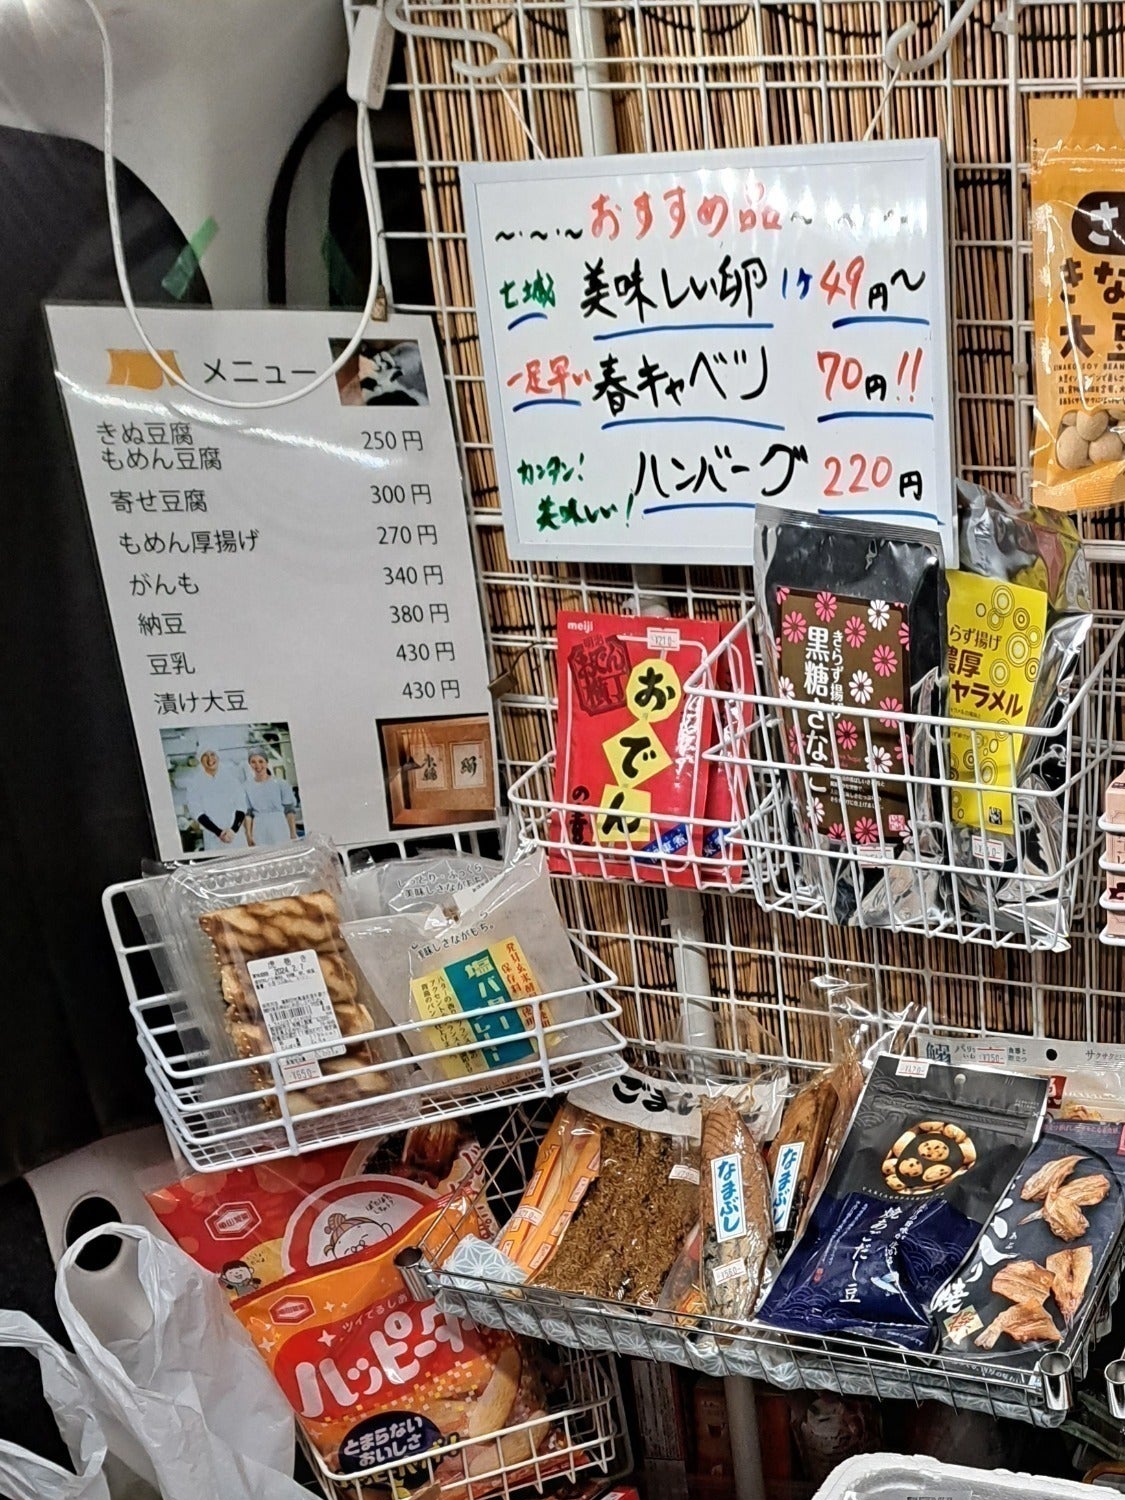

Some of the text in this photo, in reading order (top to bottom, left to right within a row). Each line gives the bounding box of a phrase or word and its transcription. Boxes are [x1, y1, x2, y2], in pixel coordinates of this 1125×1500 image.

[590, 181, 782, 241] おすすめ品
[579, 255, 768, 324] 美味しい卵
[203, 358, 317, 385] メニュー
[1103, 363, 1125, 371] BEAN
[507, 354, 592, 399] 一足早い
[592, 345, 769, 416] 春キャベツ
[96, 421, 194, 446] きぬ豆腐
[102, 447, 222, 471] もめん豆腐
[634, 443, 808, 499] ハンバーグ
[823, 455, 924, 500] 220円
[110, 490, 208, 514] 寄せ豆腐
[118, 530, 260, 556] もめん厚揚げ
[129, 573, 200, 597] がんも
[138, 612, 187, 637] 納豆
[567, 621, 593, 633] meiji
[149, 652, 195, 677] 豆乳
[154, 689, 248, 715] 漬け大豆
[602, 667, 676, 836] おでん
[717, 1159, 741, 1233] なまぶし
[773, 1145, 798, 1225] なまぶし
[344, 1416, 423, 1456] とまらない
[359, 1433, 422, 1467] おいしさ
